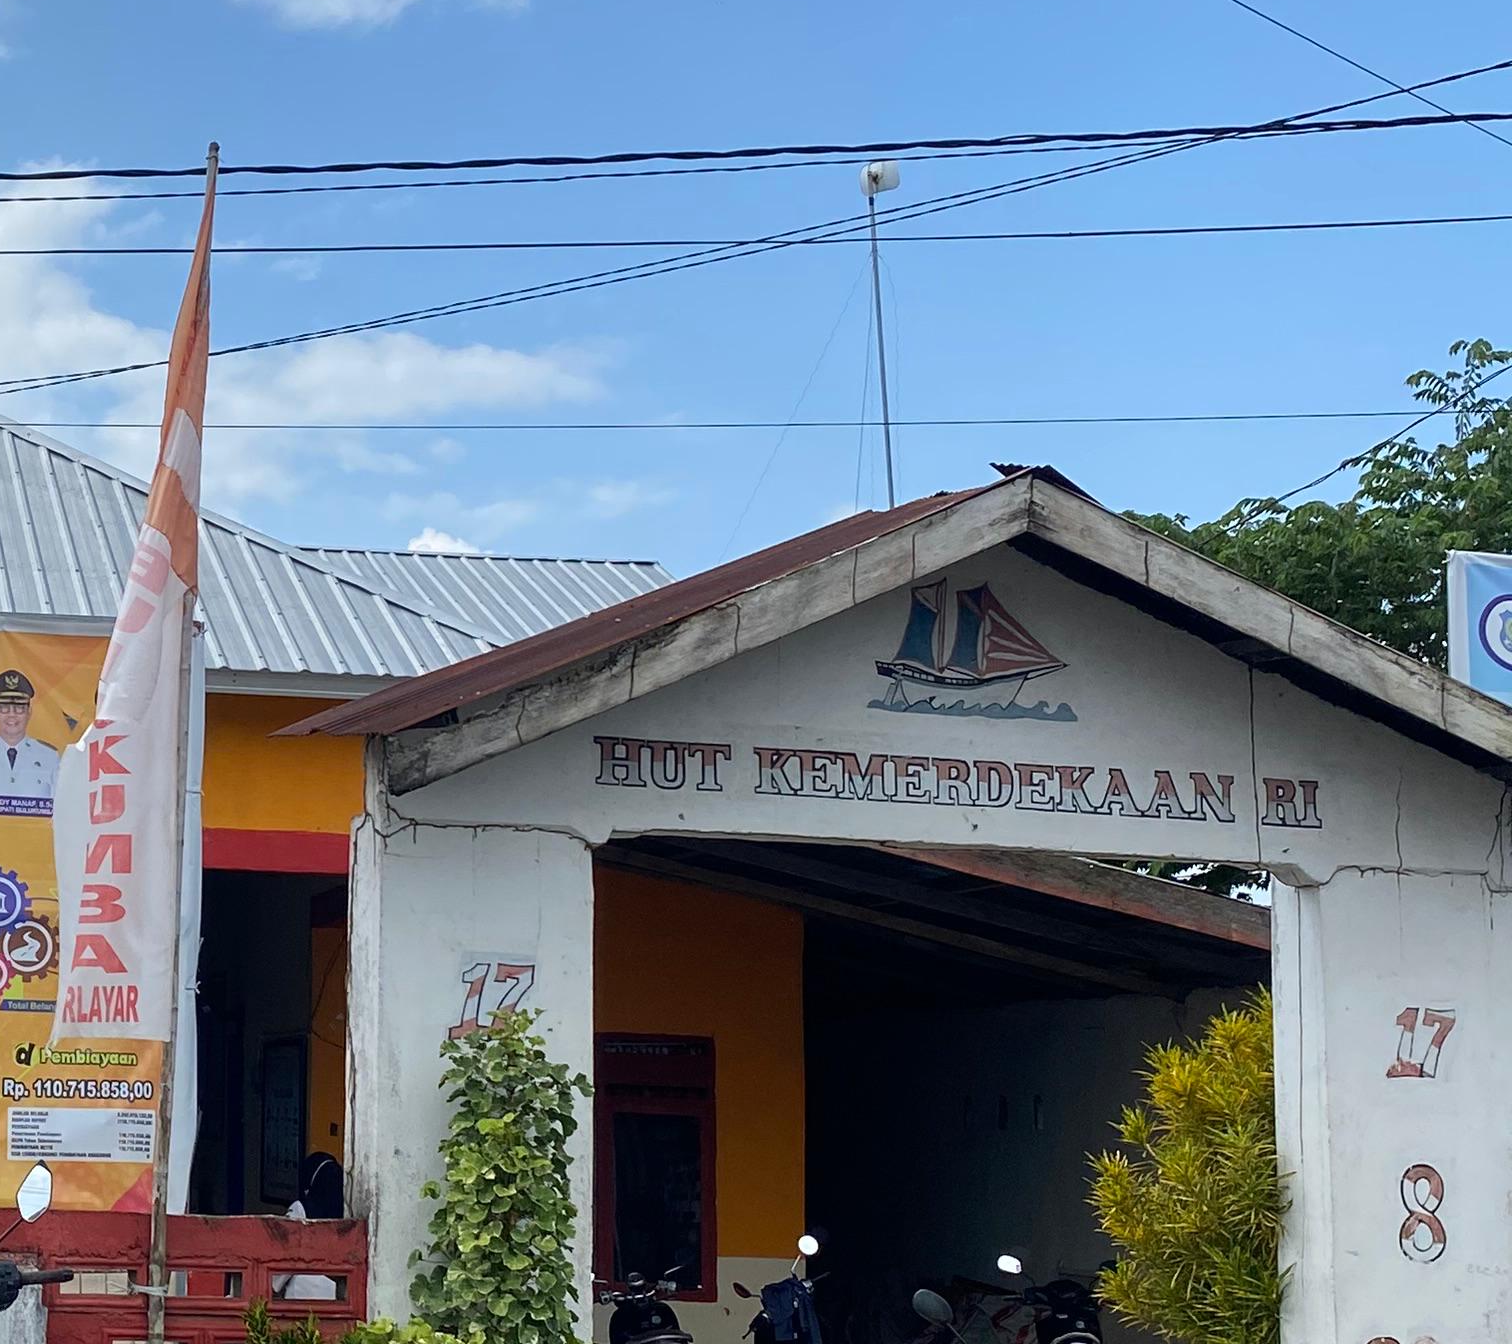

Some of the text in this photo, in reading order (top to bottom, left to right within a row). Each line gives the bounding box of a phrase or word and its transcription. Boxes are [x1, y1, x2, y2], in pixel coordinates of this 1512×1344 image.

[593, 736, 1323, 830] HUT KEMERDEKAAN RI
[8, 1000, 28, 1010] Total
[448, 962, 535, 1040] 17
[39, 1048, 138, 1067] Pembiayaan
[1386, 1007, 1457, 1079] 17
[3, 1079, 153, 1102] Rp. 110.715.858,00
[1399, 1163, 1448, 1264] 8
